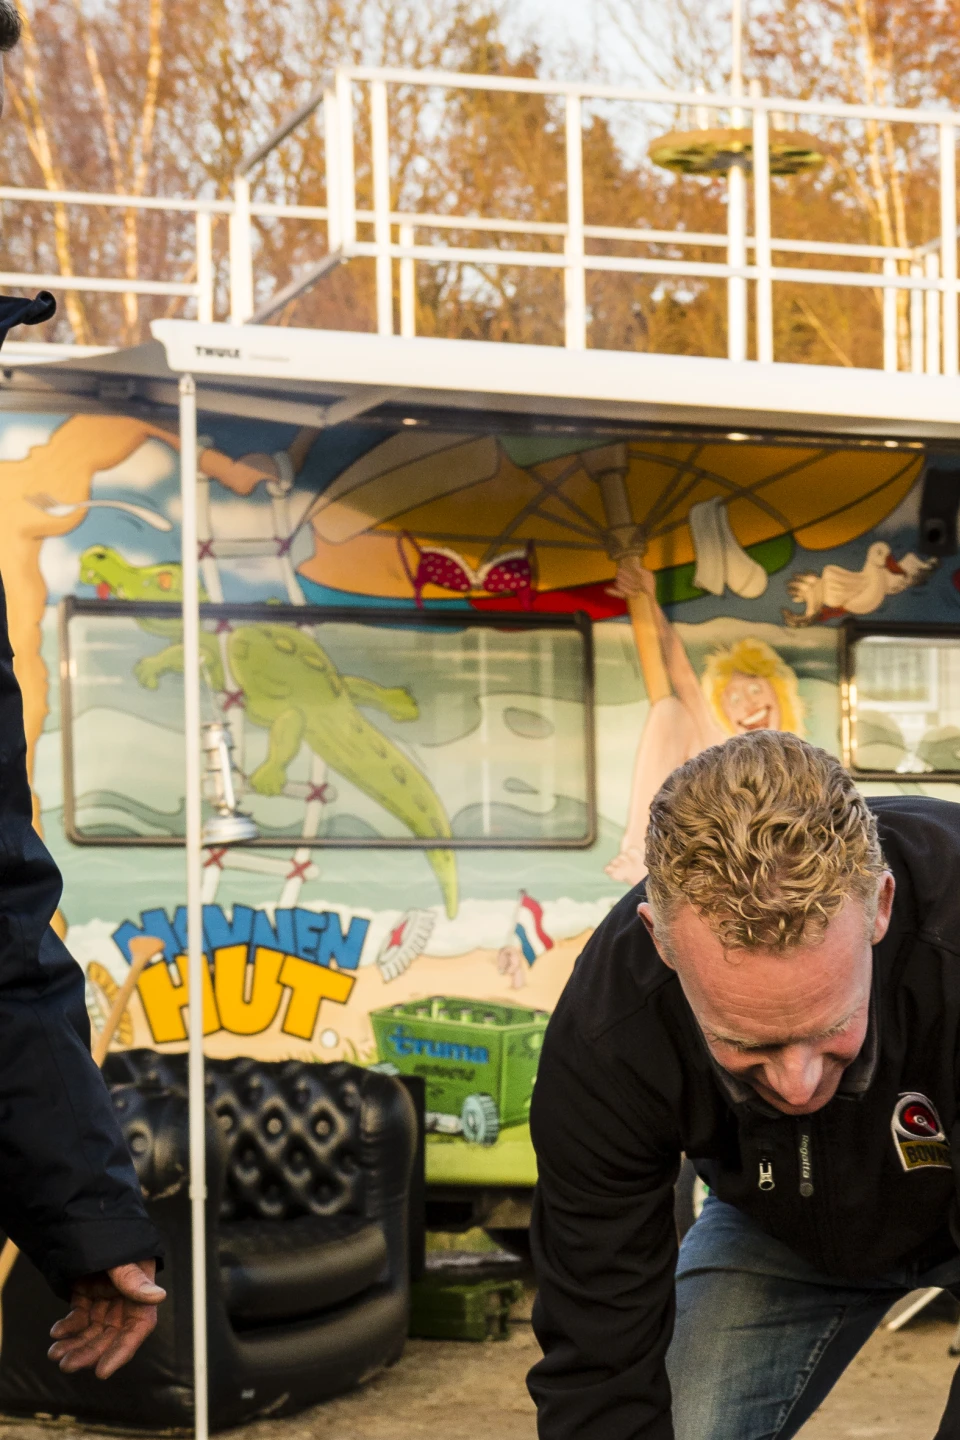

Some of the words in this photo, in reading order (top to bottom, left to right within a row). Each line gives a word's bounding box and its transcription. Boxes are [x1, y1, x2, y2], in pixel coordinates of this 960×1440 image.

[136, 943, 356, 1045] HUT
[387, 1023, 490, 1065] truma
[799, 1134, 812, 1179] Regatta
[905, 1144, 951, 1164] BOVA
